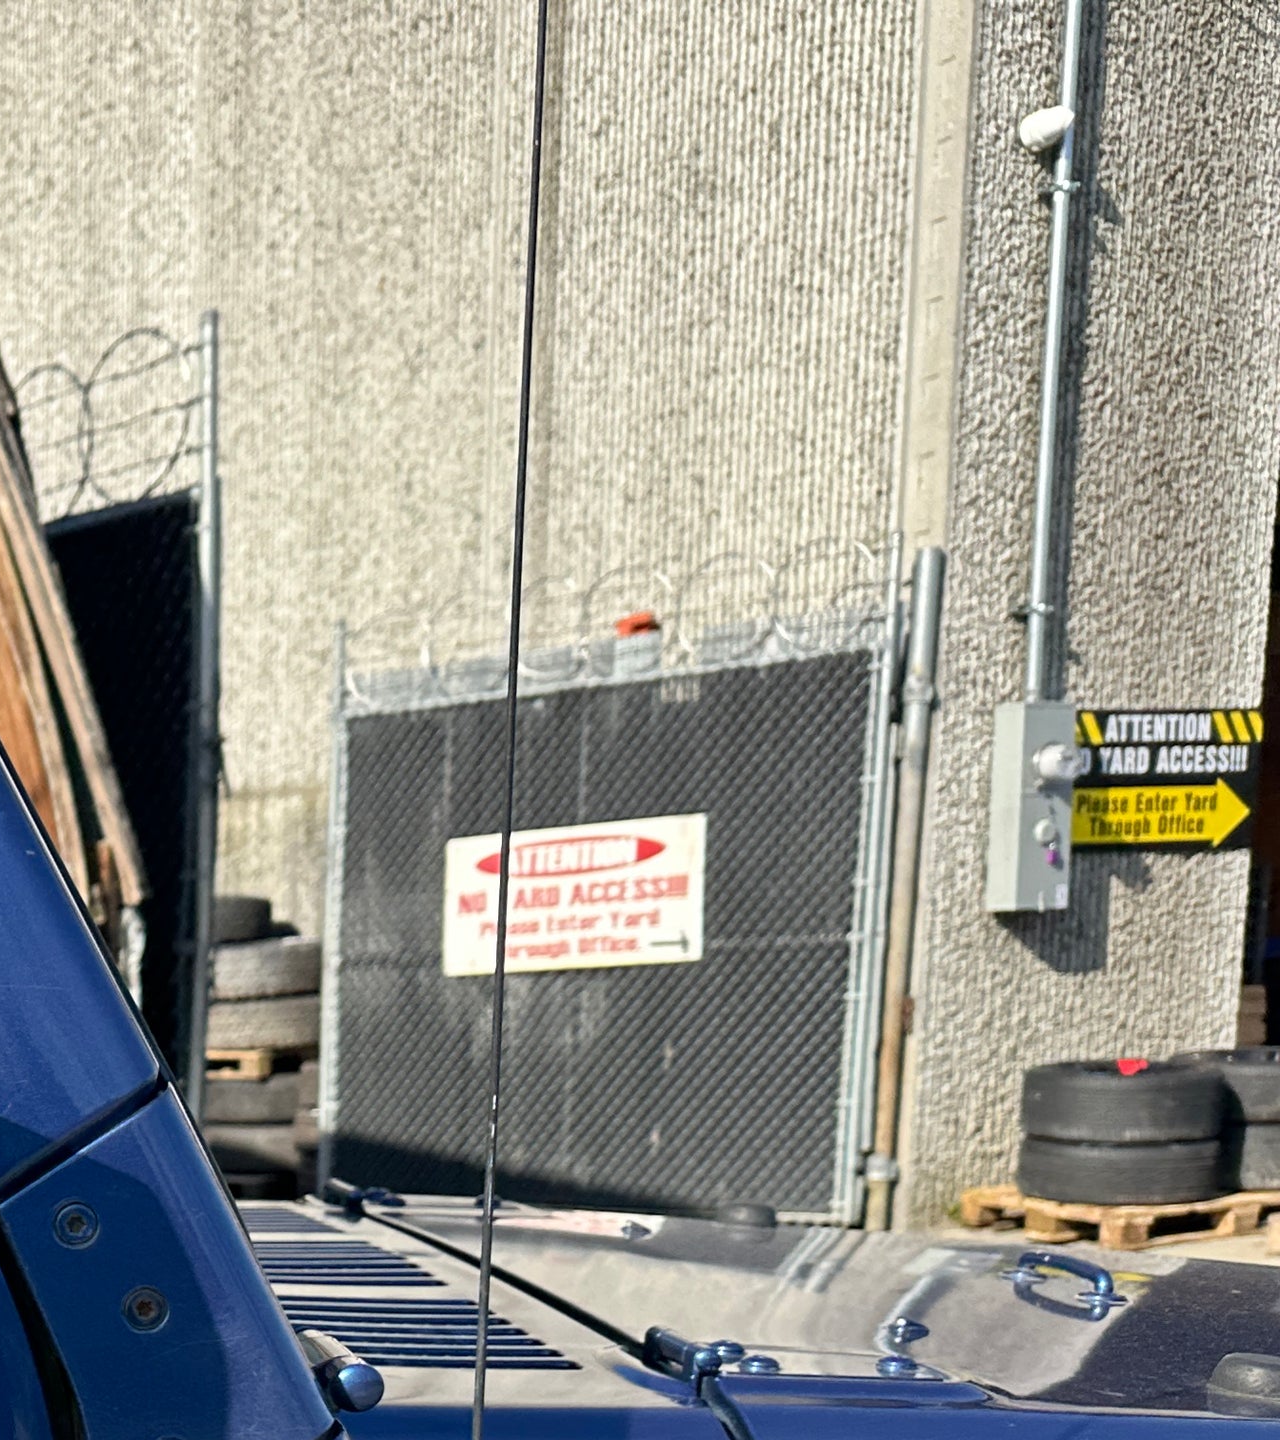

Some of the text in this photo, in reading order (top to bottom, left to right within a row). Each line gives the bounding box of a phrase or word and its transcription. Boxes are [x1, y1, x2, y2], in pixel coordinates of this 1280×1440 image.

[1105, 713, 1212, 742] ATTENTION
[1099, 746, 1150, 774] YARD
[1155, 744, 1249, 774] ACCESS!!!
[1076, 791, 1218, 813] Please Enter Yard
[1091, 812, 1205, 837] Through Office
[458, 891, 487, 915] NO
[512, 885, 561, 911] ARD
[546, 913, 603, 933] Enter
[609, 908, 661, 928] Yard
